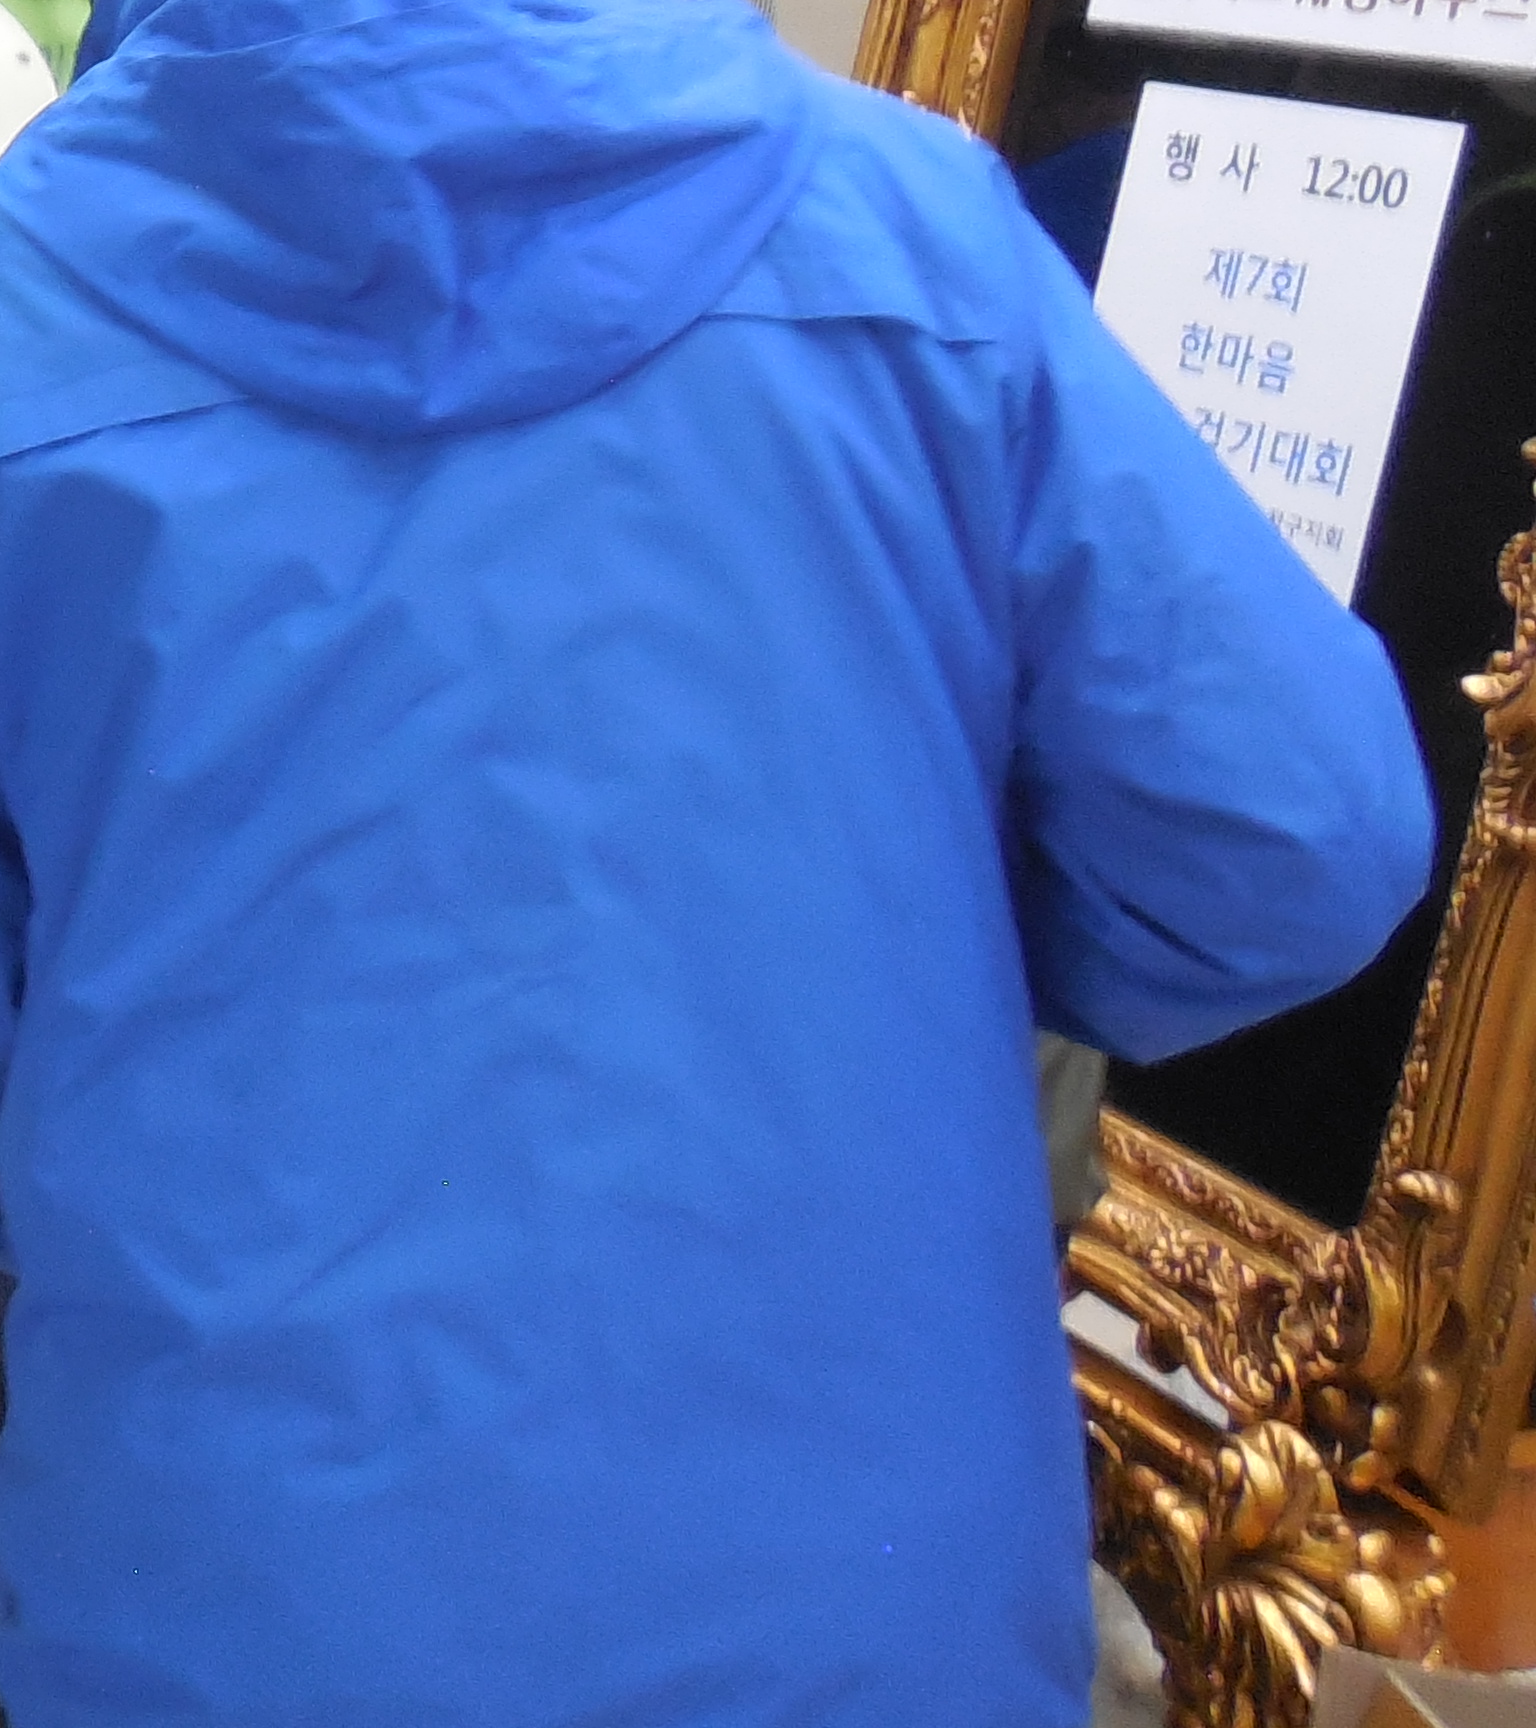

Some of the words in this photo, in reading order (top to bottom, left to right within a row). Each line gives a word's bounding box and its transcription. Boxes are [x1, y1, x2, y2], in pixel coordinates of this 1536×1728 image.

[1302, 155, 1409, 209] 12:00
[1204, 248, 1308, 313] 제7회
[1178, 322, 1295, 395] 한마음
